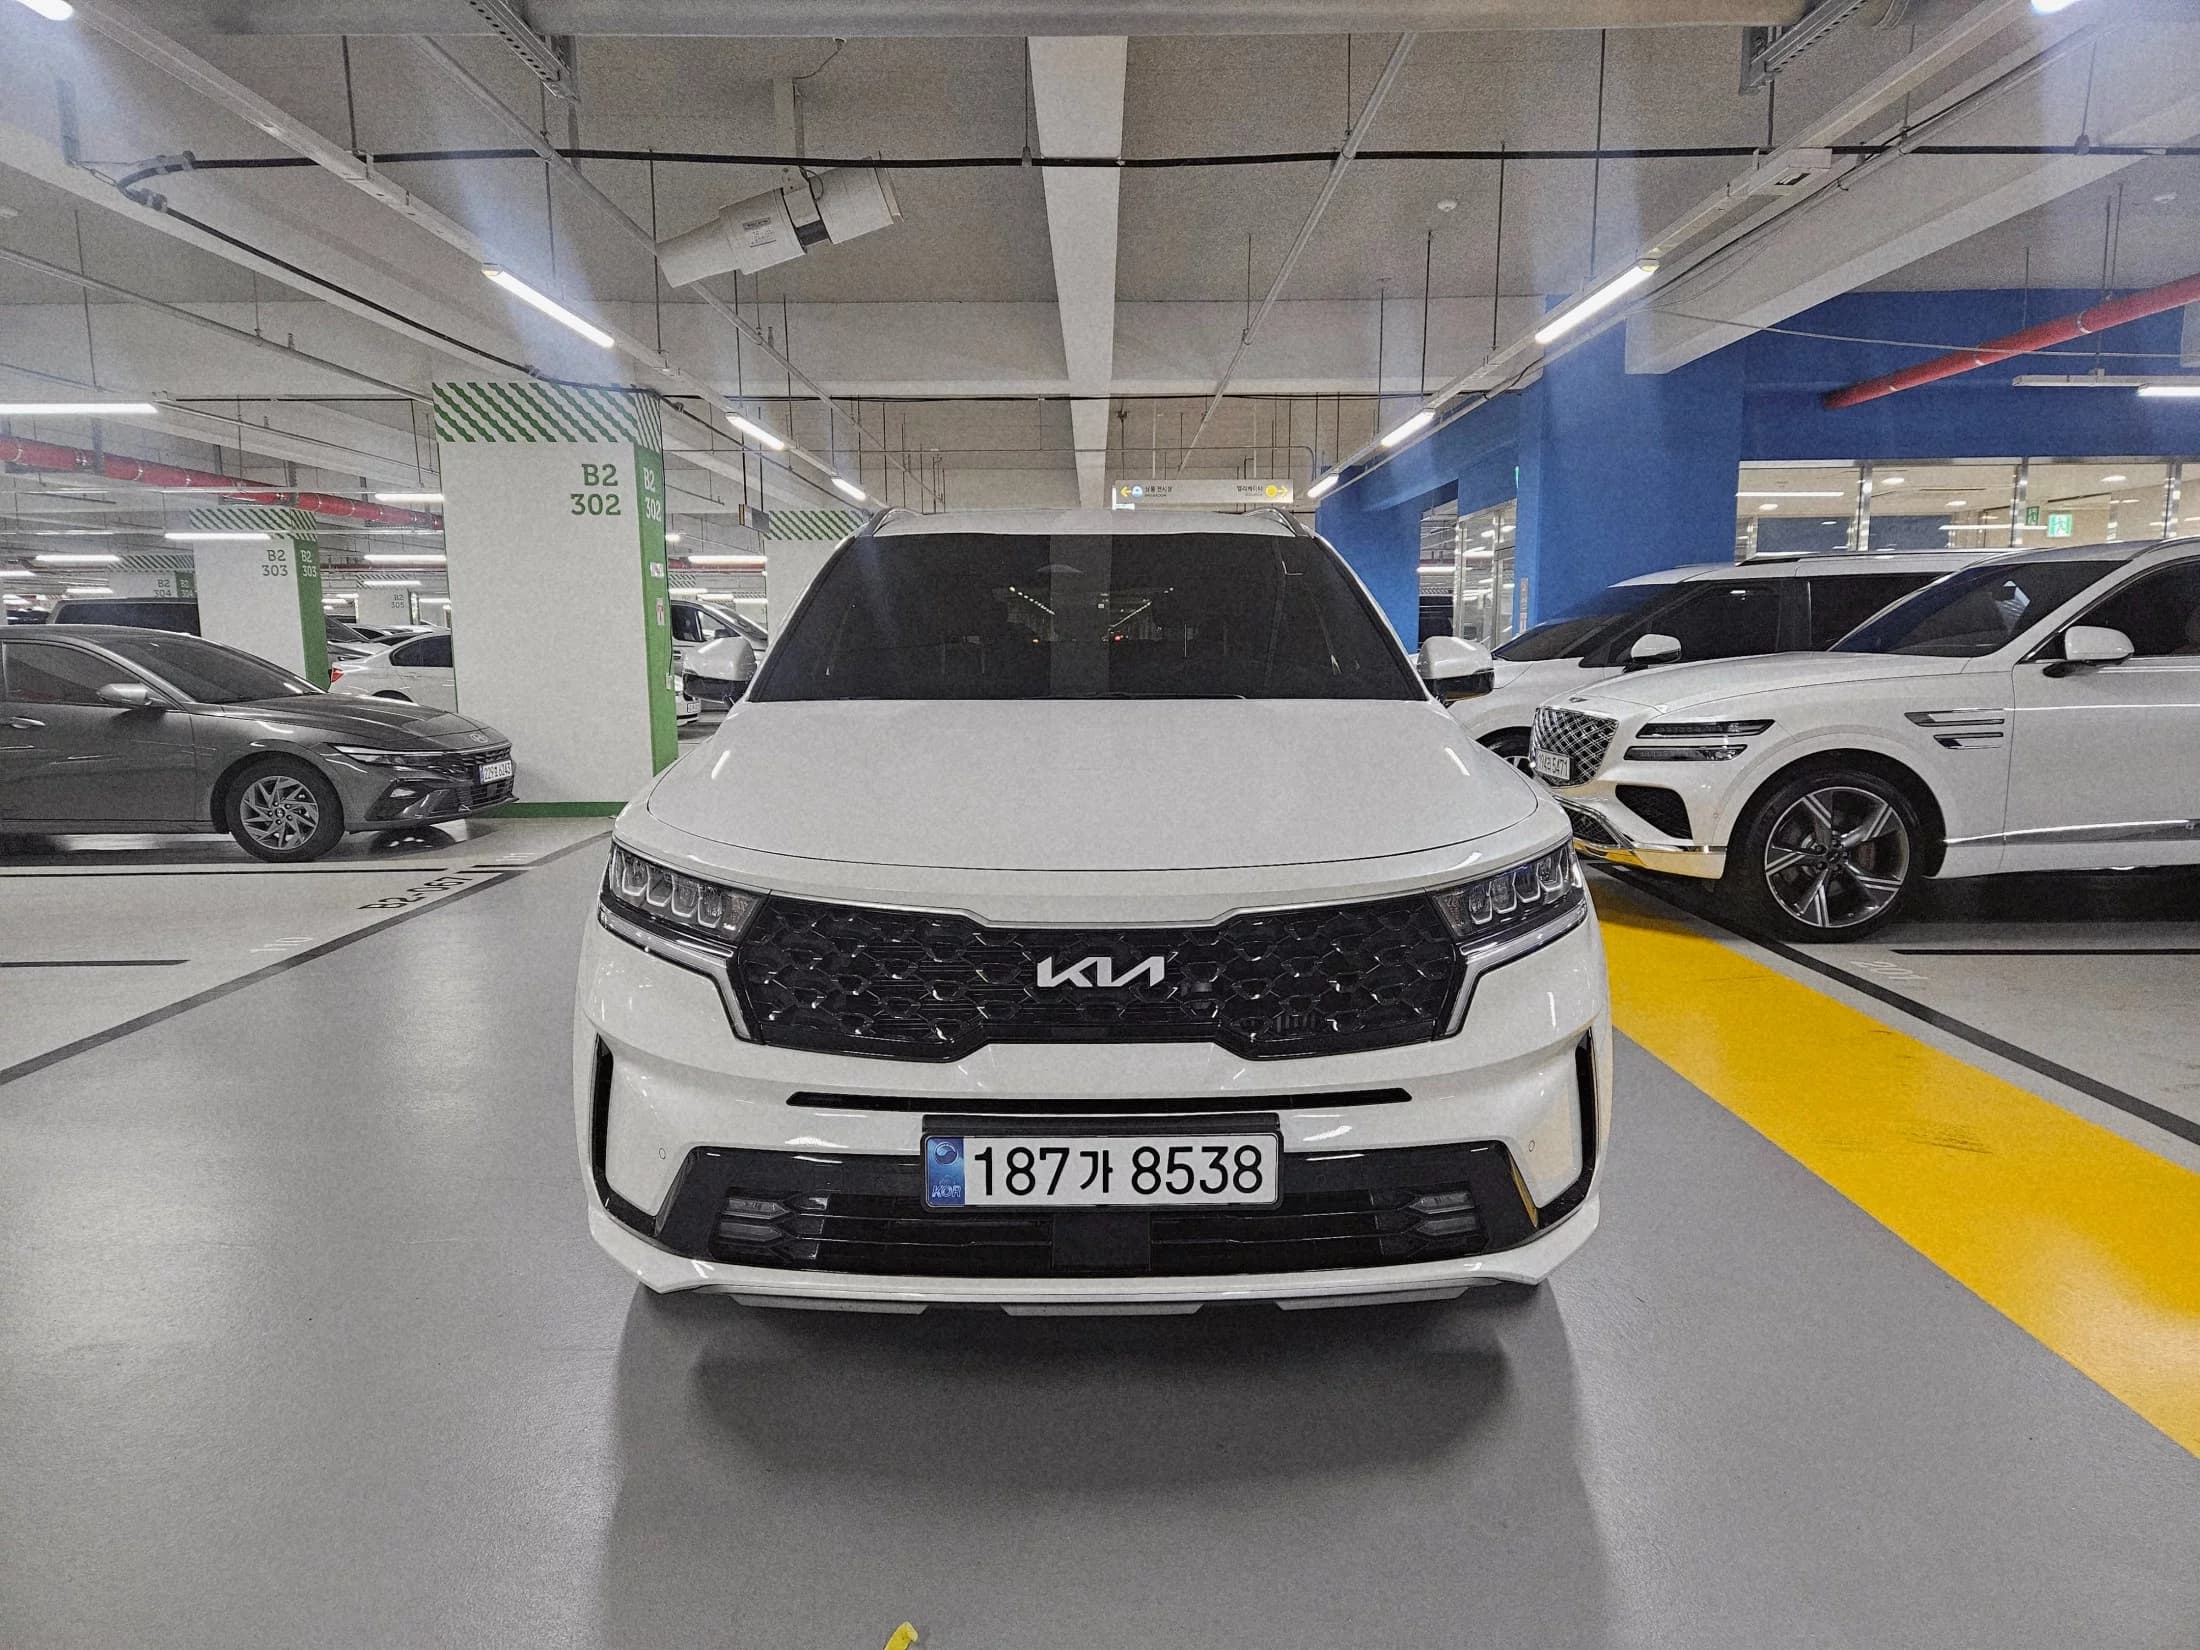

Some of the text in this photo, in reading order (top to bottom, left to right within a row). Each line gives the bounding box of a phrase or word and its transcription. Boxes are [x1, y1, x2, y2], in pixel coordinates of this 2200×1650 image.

[581, 464, 618, 486] B2
[643, 467, 656, 492] B2
[570, 493, 621, 515] 302
[645, 496, 661, 521] 302
[267, 549, 286, 561] B2
[300, 550, 312, 563] B2
[262, 565, 288, 576] 303
[302, 565, 317, 577] 303
[157, 579, 170, 588] B2
[357, 876, 472, 910] B2-067
[1037, 956, 1165, 987] KIA
[974, 1145, 1263, 1195] 187가 8538
[932, 1185, 961, 1198] KOR
